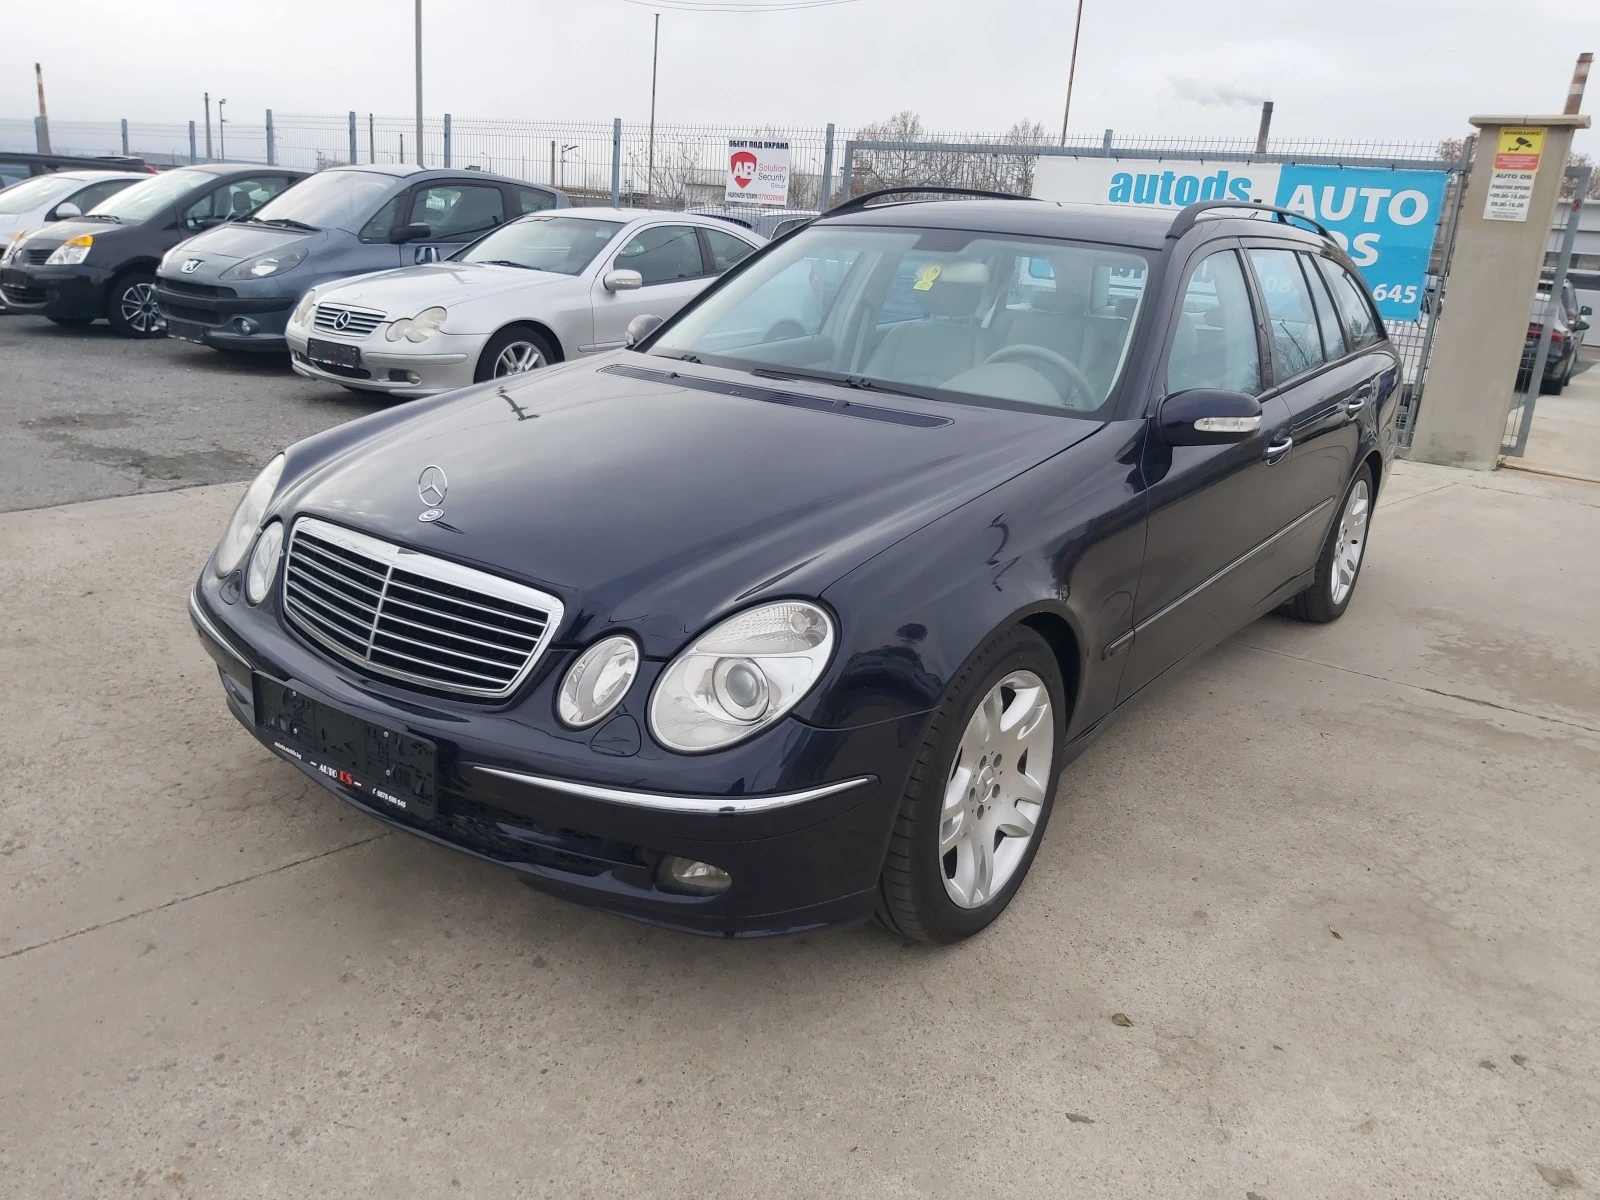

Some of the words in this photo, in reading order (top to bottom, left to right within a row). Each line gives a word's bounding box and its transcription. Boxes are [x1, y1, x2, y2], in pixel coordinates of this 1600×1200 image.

[728, 140, 748, 148] ОБЕКТ
[749, 141, 763, 149] ПОД
[764, 142, 789, 150] ОХРАНА
[732, 161, 755, 180] AB
[758, 163, 787, 173] Solution
[757, 172, 787, 183] Security
[770, 182, 786, 190] Group
[1286, 184, 1429, 226] AUTO
[1372, 283, 1418, 304] 645
[318, 763, 338, 779] AUTO
[339, 770, 353, 785] DS
